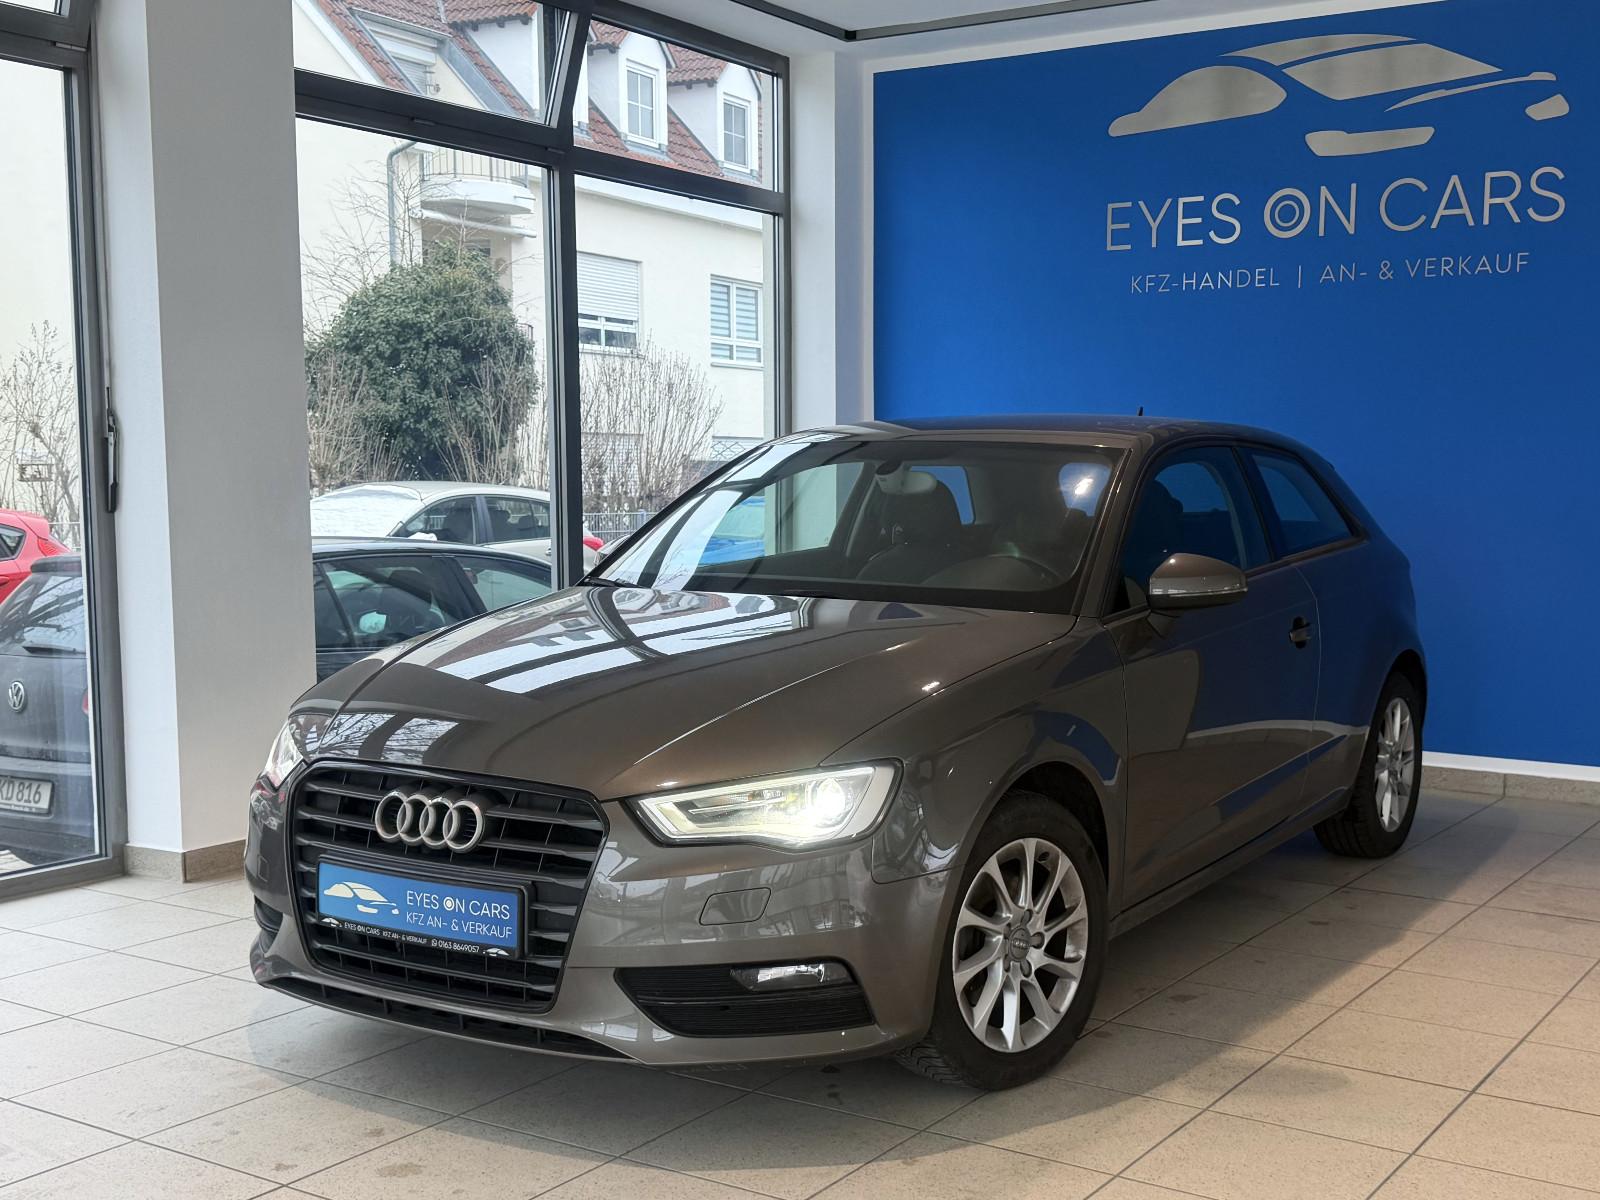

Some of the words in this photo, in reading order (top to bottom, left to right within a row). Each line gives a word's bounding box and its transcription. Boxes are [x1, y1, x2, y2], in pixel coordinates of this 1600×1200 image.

[1105, 193, 1242, 251] EYES
[1263, 182, 1358, 239] ON
[1379, 166, 1567, 232] CARS
[1130, 269, 1281, 294] KFZ-HANDEL
[1319, 263, 1368, 284] AN-
[1378, 260, 1395, 281] &
[1404, 252, 1530, 278] VERKAUF
[16, 781, 42, 804] 816
[406, 890, 440, 910] EYES
[443, 897, 466, 914] ON
[469, 901, 511, 920] CARS
[344, 922, 357, 932] EYES
[366, 926, 380, 936] CARS
[382, 930, 392, 939] KFZ
[406, 935, 428, 945] VERKAUF
[438, 940, 452, 950] 0163
[406, 912, 425, 926] KFZ
[427, 915, 448, 929] AN-
[451, 919, 460, 931] &
[461, 921, 513, 939] VERKAUF
